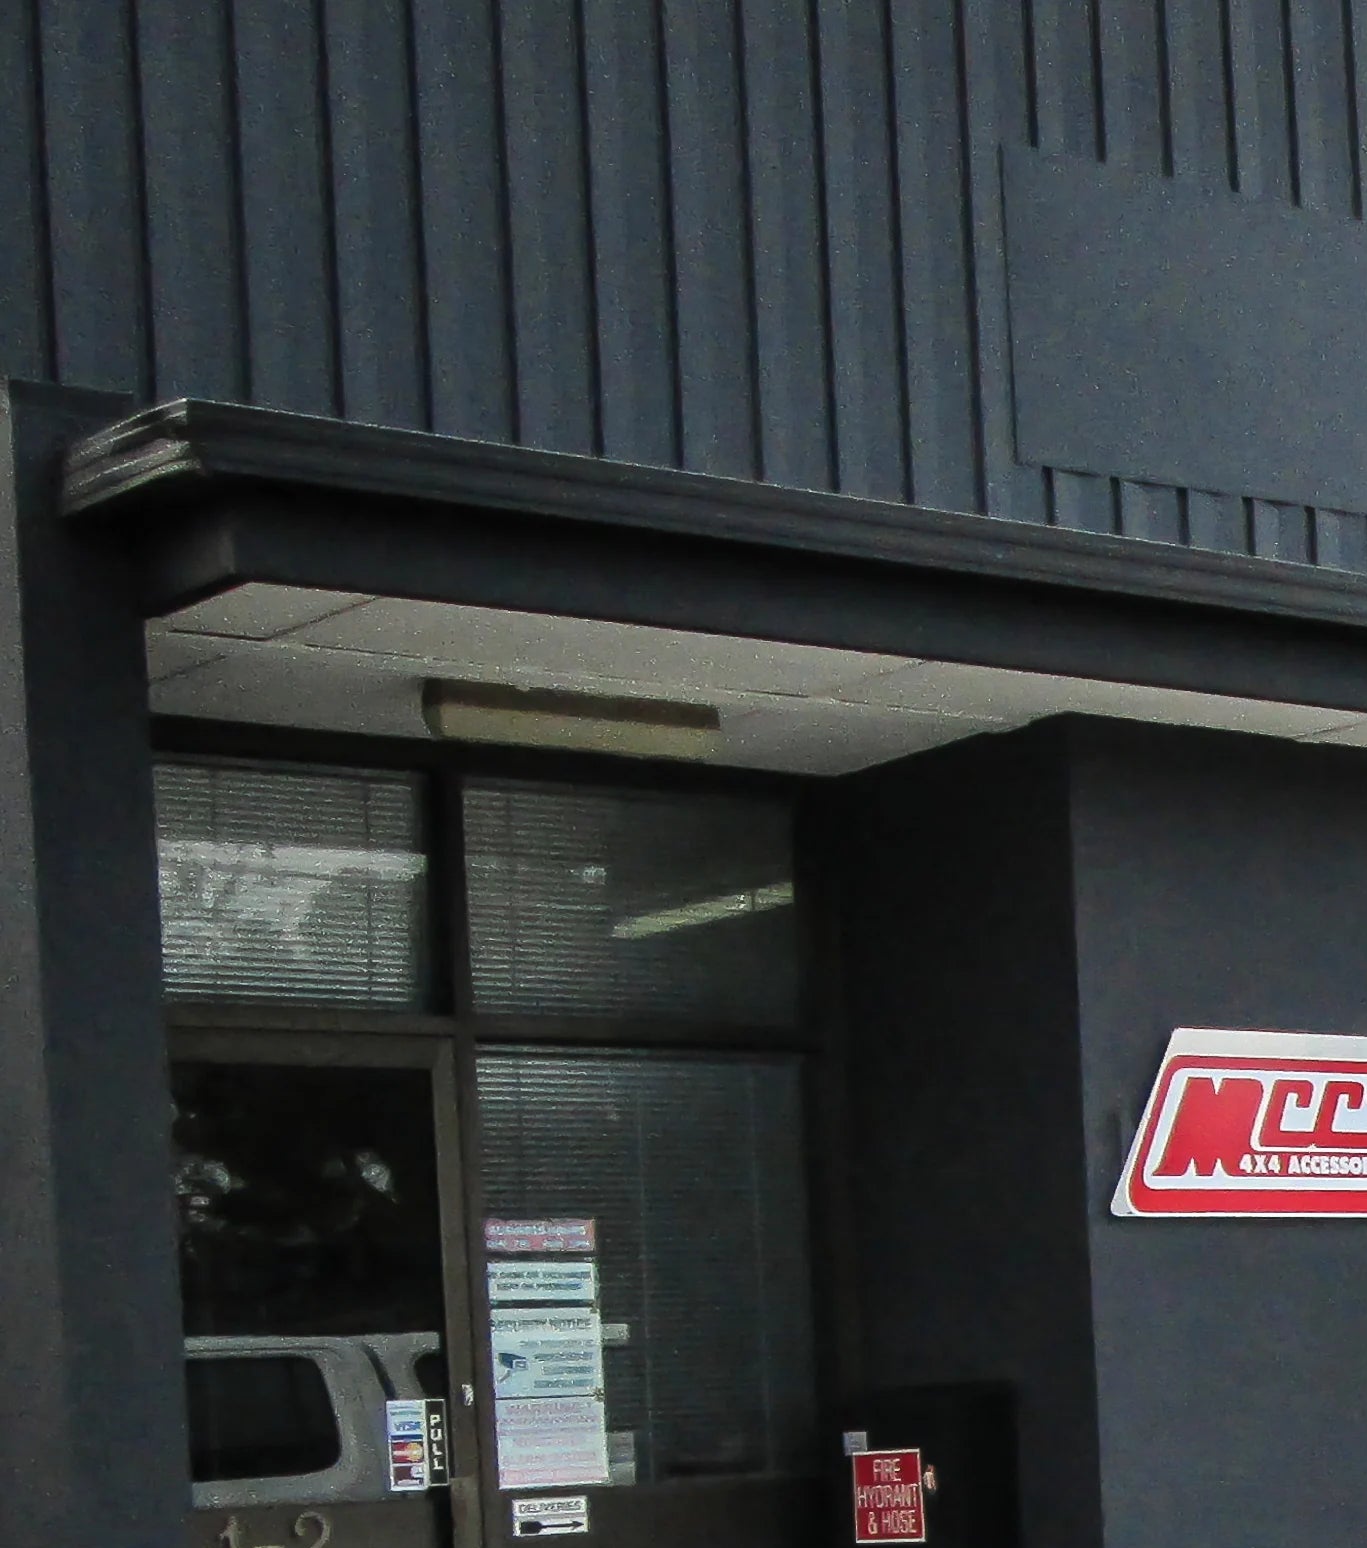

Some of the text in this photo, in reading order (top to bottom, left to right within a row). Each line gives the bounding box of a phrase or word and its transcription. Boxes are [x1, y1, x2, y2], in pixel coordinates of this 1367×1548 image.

[1239, 1153, 1281, 1174] 4X4
[429, 1414, 444, 1470] PULL
[873, 1458, 902, 1482] FIRE
[857, 1484, 918, 1509] HYDRANT
[882, 1510, 917, 1533] HOSE
